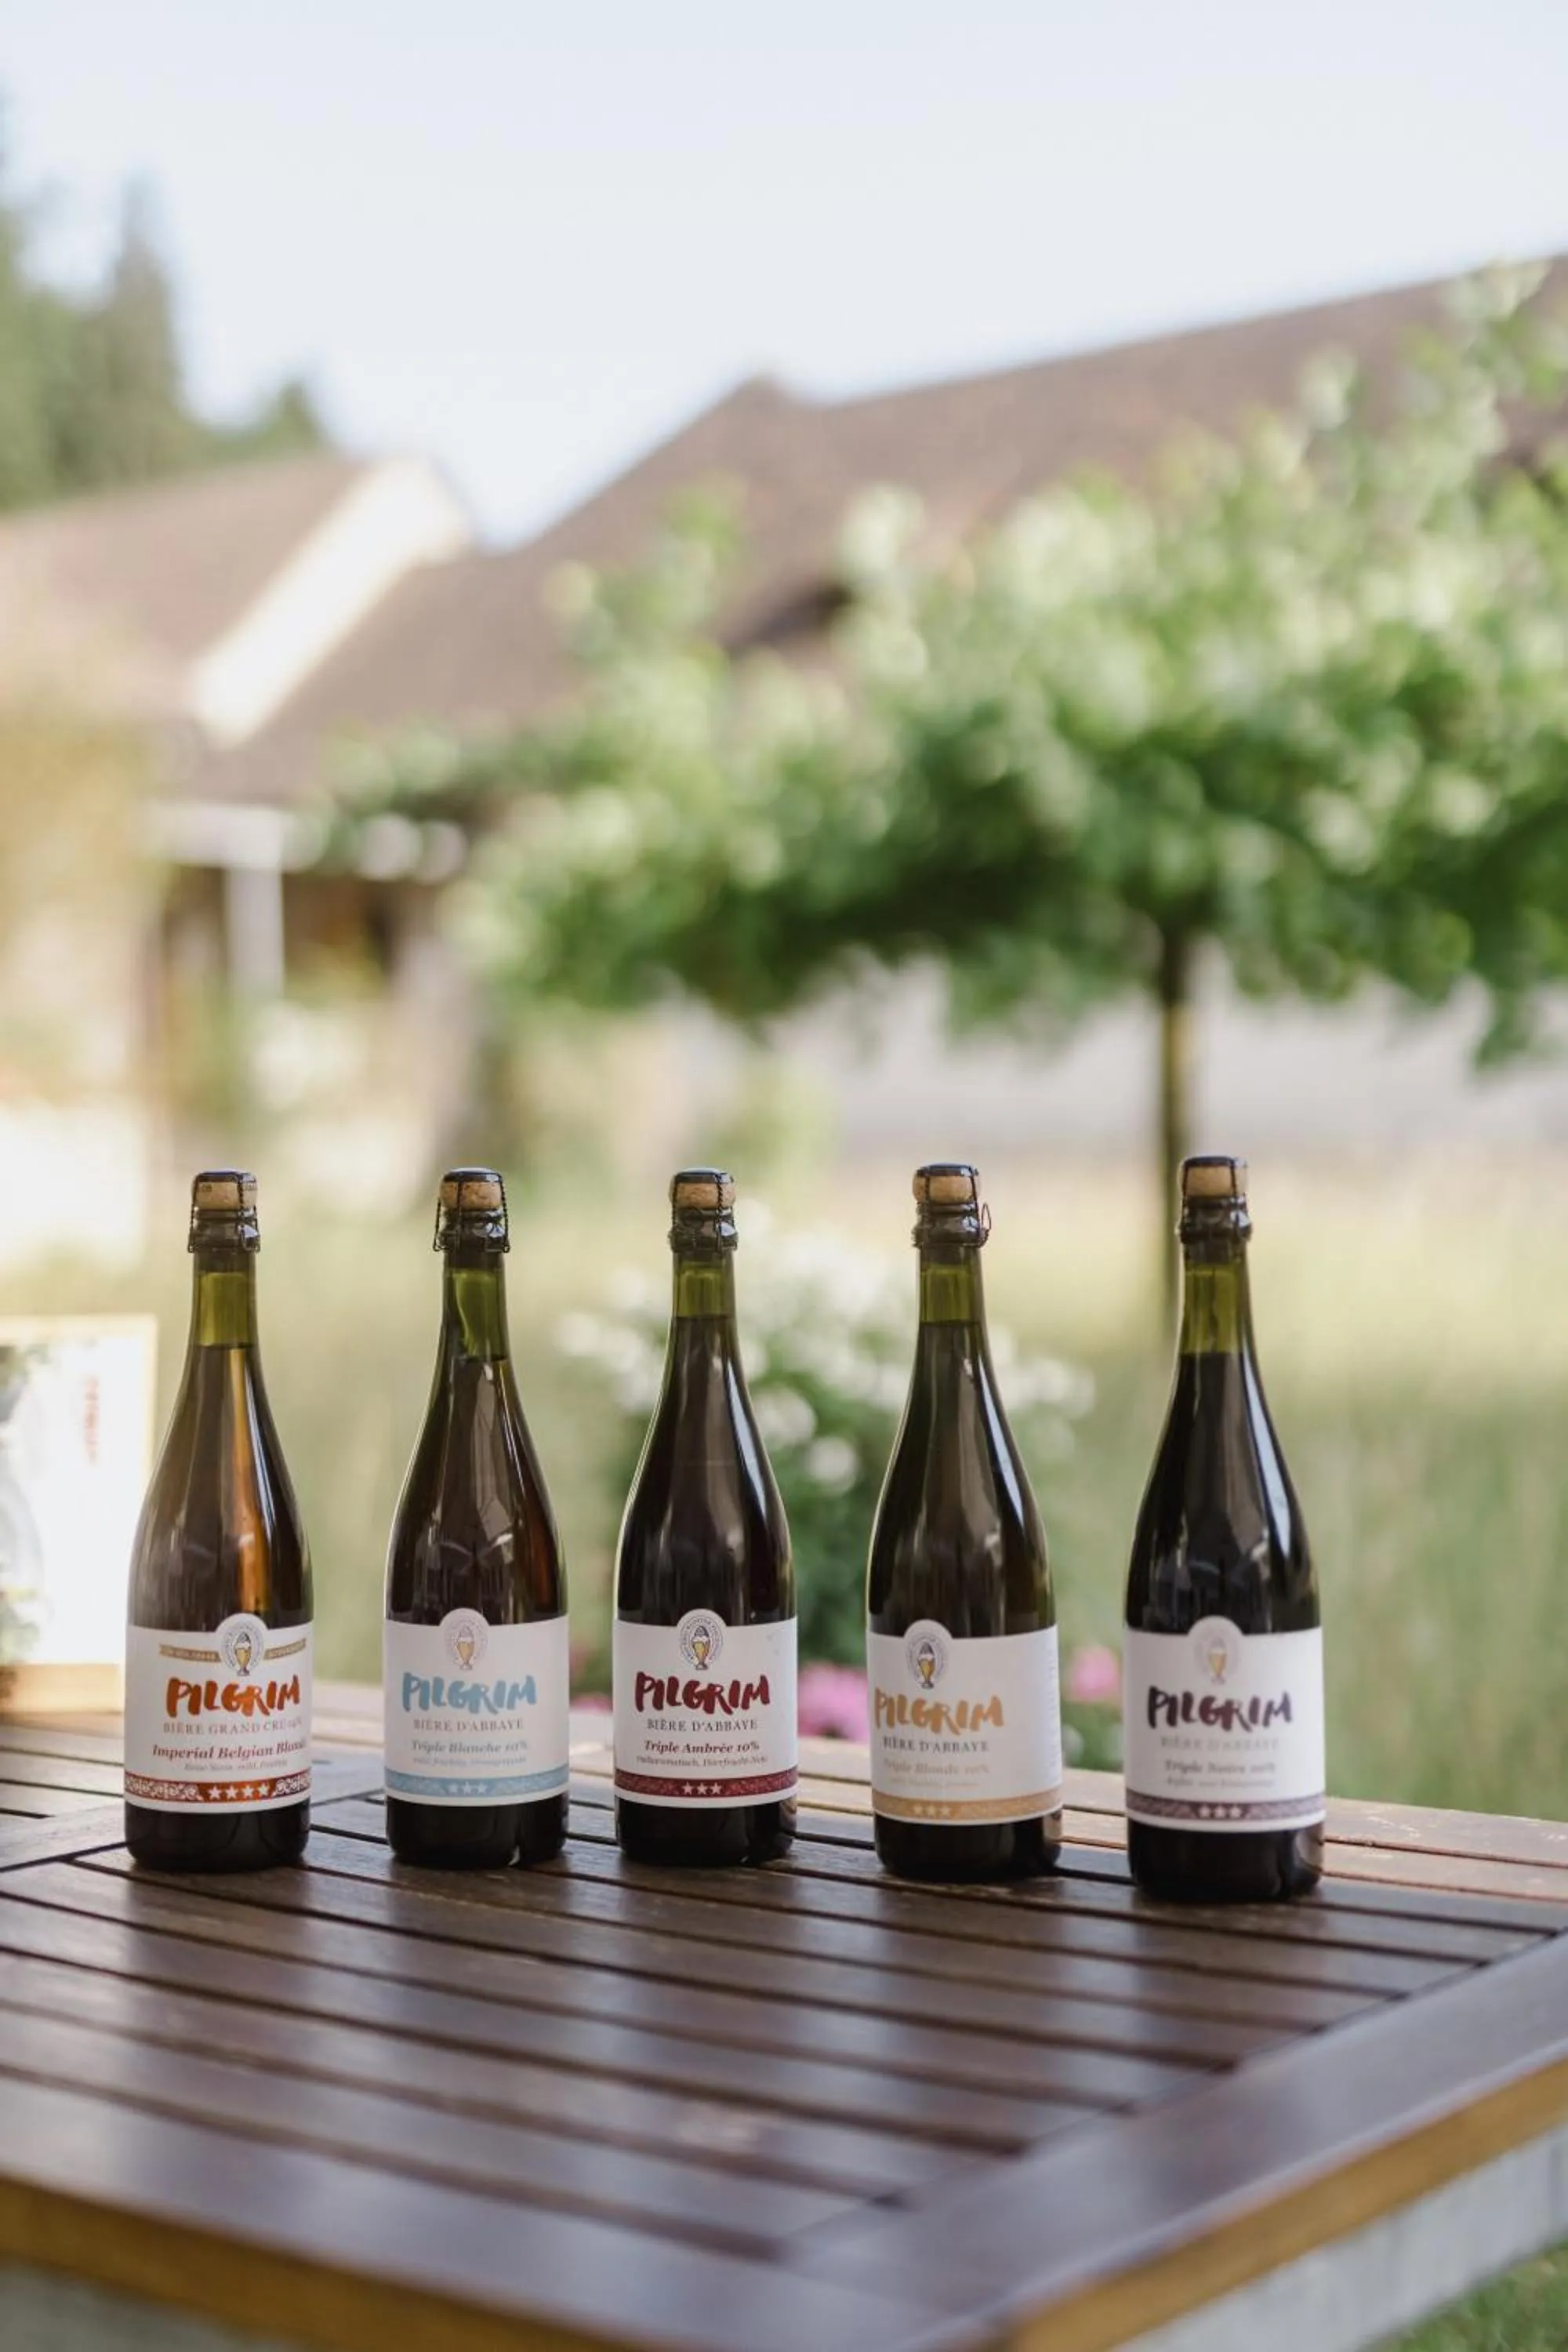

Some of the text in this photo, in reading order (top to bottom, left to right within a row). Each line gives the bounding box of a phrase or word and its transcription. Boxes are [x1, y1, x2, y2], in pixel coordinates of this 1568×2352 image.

[166, 1674, 300, 1718] PILGRIM
[402, 1671, 537, 1715] PILGRIM
[635, 1671, 770, 1715] PILGRIM
[874, 1687, 1004, 1735] PILGRIM
[1147, 1684, 1293, 1733] PILGRIM
[209, 1723, 260, 1735] GRAND
[457, 1718, 524, 1732] D'ABBAYE
[691, 1718, 758, 1732] D'ABBAYE
[153, 1744, 214, 1762] Imperial
[217, 1745, 273, 1761] Belgian
[411, 1739, 447, 1755] Triple
[448, 1741, 501, 1754] Blanche
[644, 1740, 760, 1755] Triple Ambrée 10%
[919, 1740, 990, 1753] D'ABBAYE
